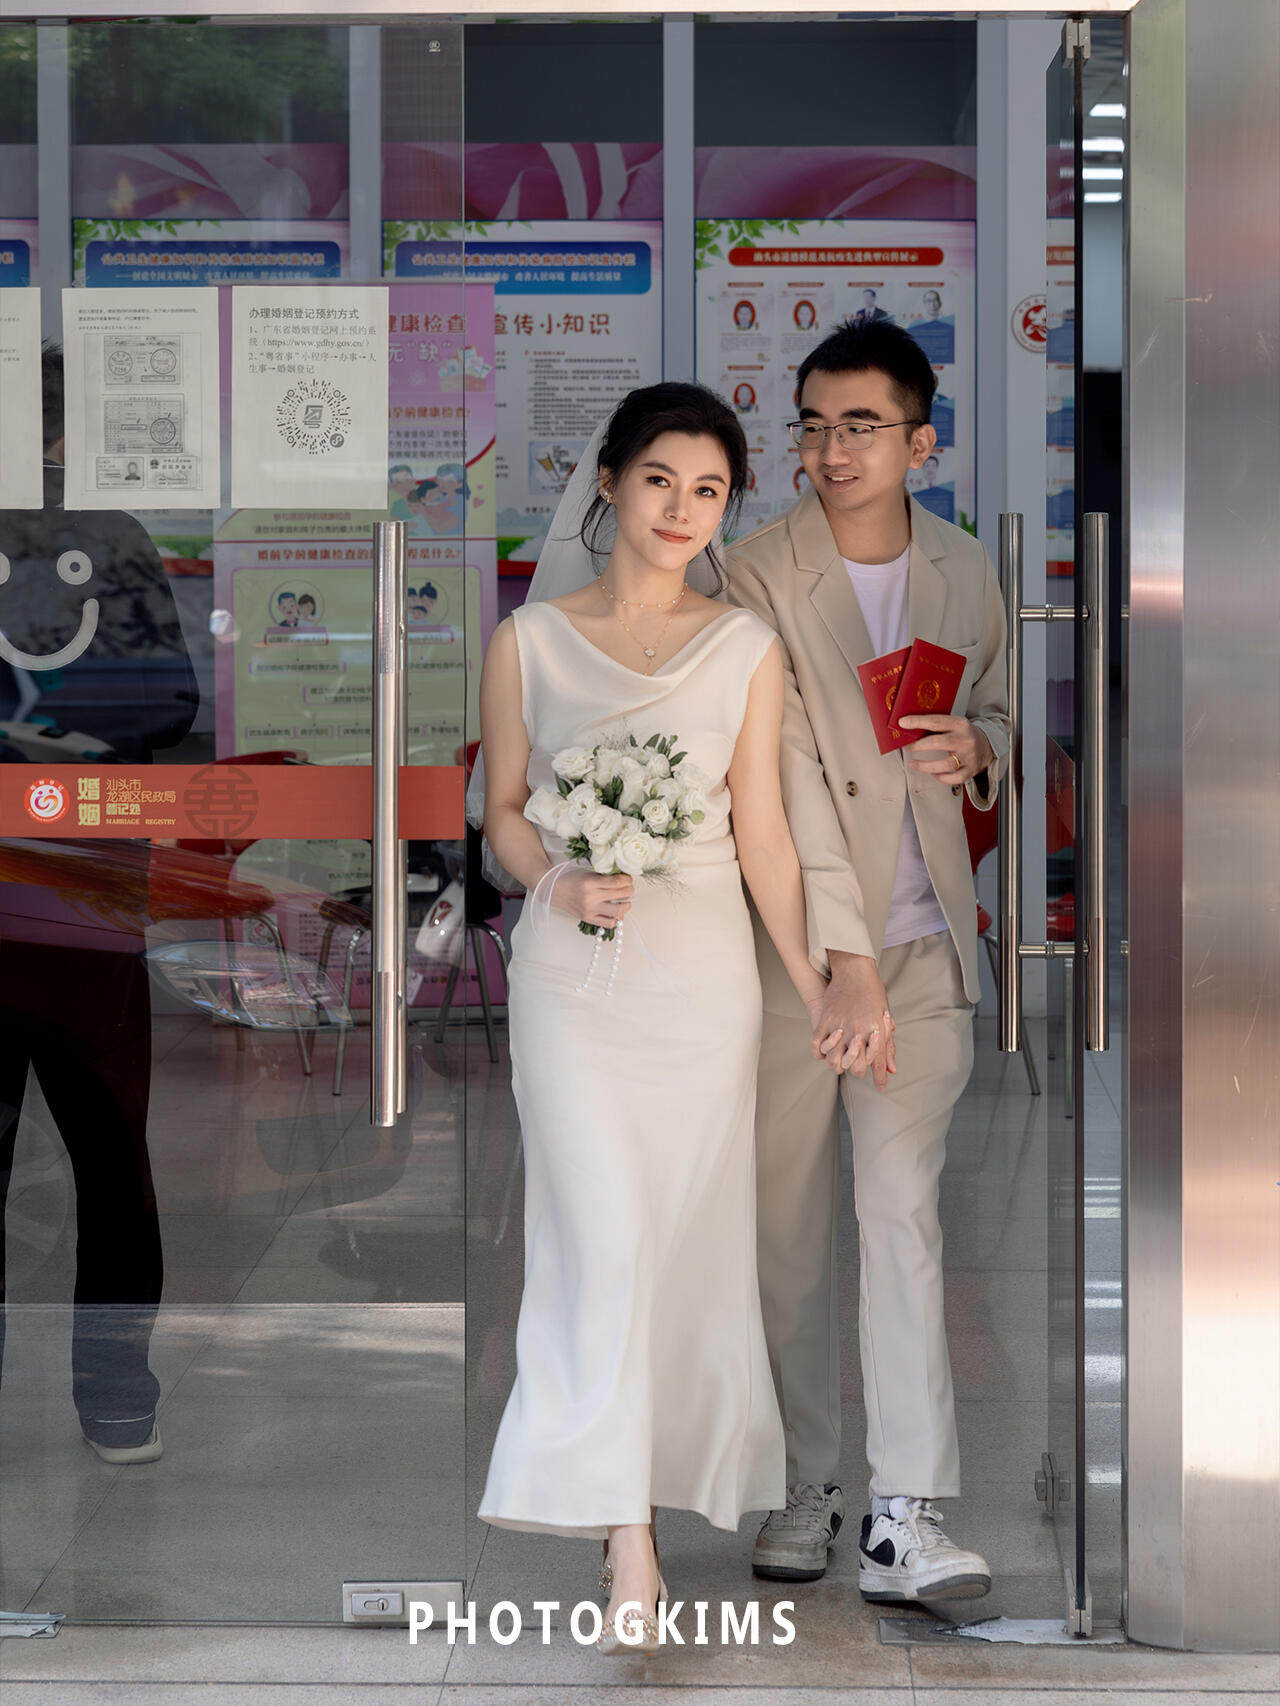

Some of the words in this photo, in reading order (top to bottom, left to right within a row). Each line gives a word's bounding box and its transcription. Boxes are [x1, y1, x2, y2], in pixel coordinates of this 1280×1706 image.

[248, 307, 360, 319] 办理婚姻登记预约方式
[105, 778, 142, 791] 汕头市
[105, 790, 177, 803] 龙湖区民政局
